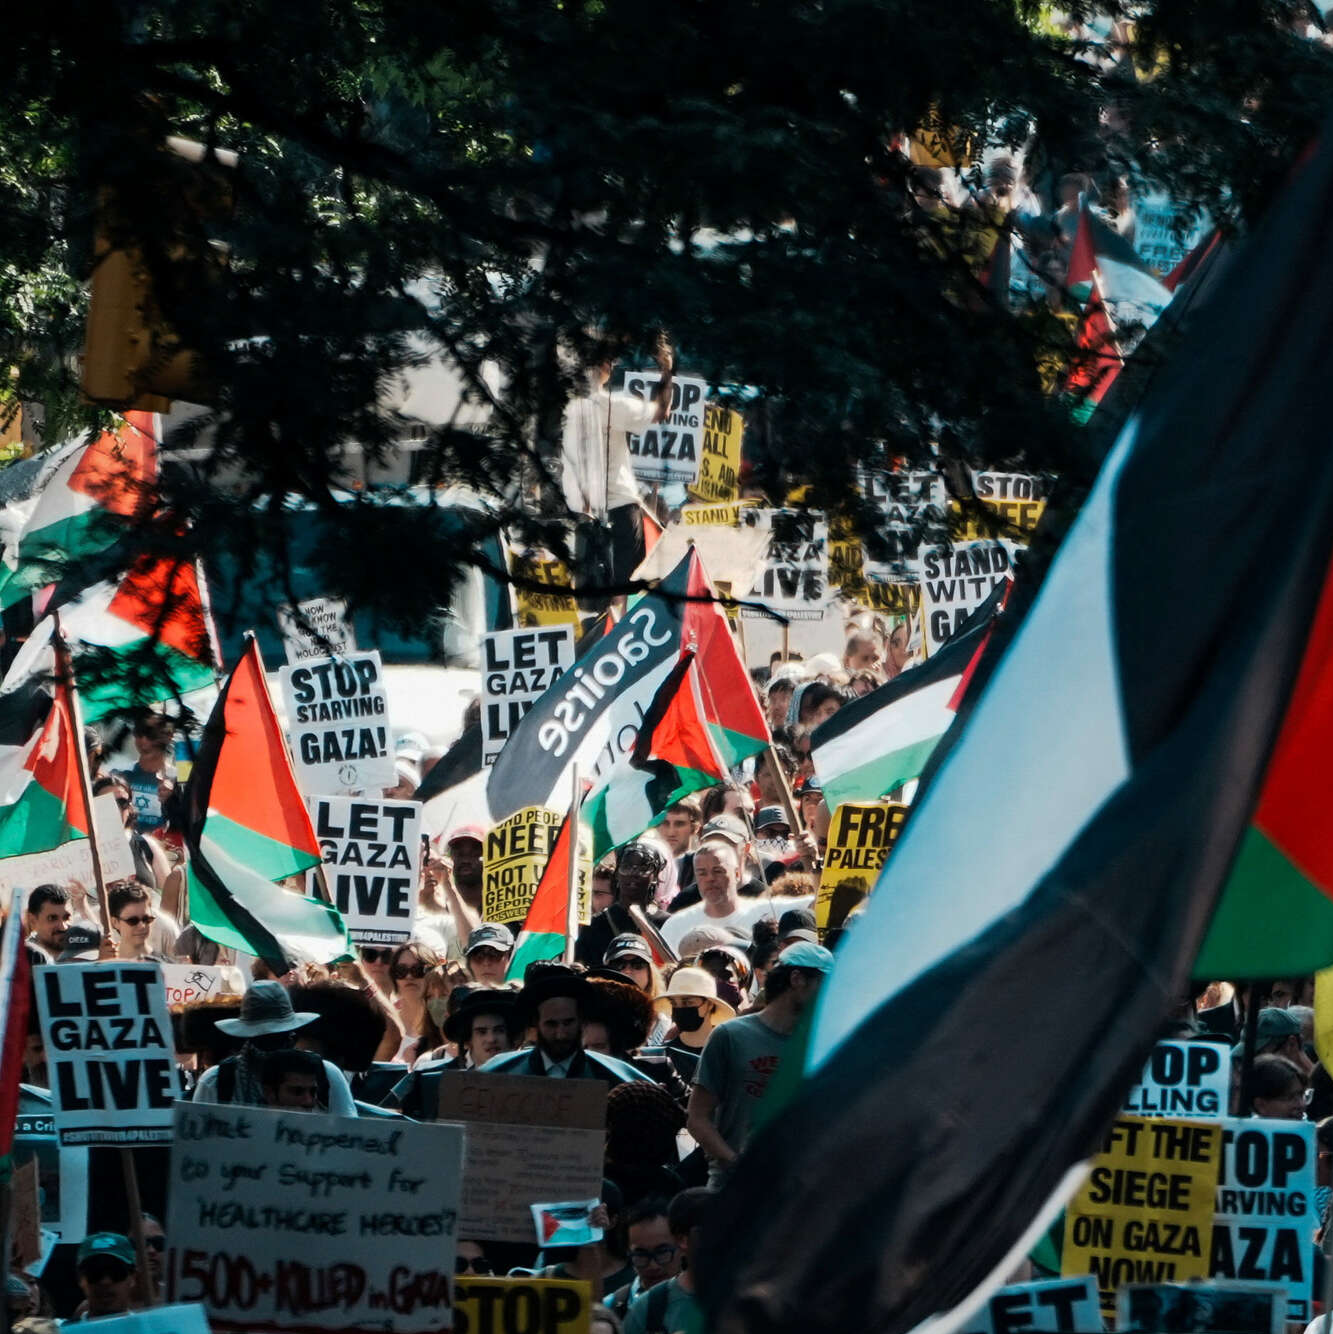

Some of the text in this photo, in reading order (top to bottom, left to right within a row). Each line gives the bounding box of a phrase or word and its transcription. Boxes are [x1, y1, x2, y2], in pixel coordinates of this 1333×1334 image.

[704, 405, 732, 432] END
[704, 431, 728, 458] ALL
[924, 550, 1008, 579] STAND
[486, 631, 570, 672] LET
[290, 659, 378, 706] STOP
[296, 696, 385, 723] STARVING
[300, 726, 388, 764] GAZA!
[316, 803, 417, 840] LET
[318, 842, 413, 870] GAZA
[486, 865, 526, 891] NOT
[44, 969, 160, 1017] LET
[50, 1018, 165, 1052] GAZA
[56, 1058, 174, 1110] LIVE
[274, 1121, 402, 1158] happened
[1152, 1123, 1212, 1163] THE
[220, 1163, 266, 1191] your
[1090, 1166, 1192, 1211] SIEGE
[1073, 1216, 1201, 1258] ON GAZA
